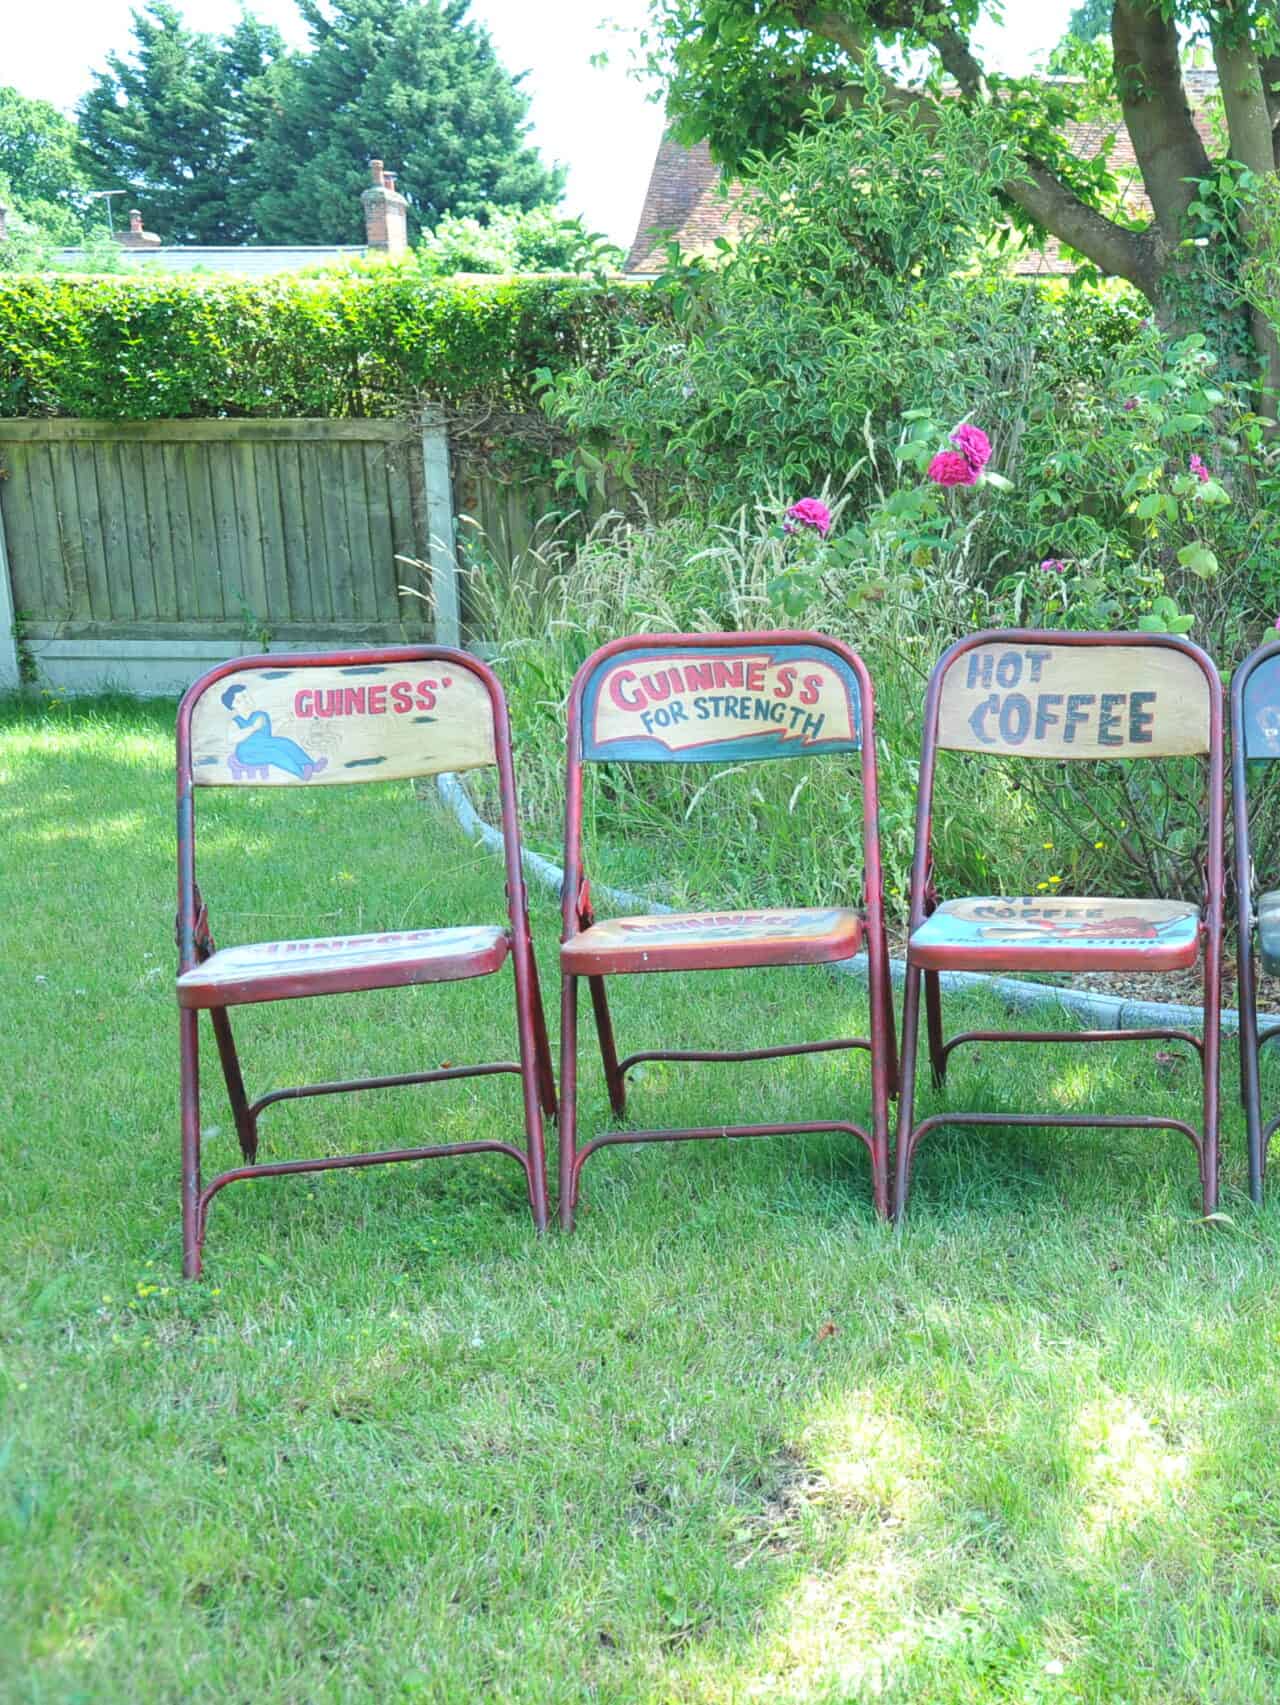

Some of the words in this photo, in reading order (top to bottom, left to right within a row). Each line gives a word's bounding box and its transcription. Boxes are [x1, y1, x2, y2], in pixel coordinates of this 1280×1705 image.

[609, 660, 823, 712] GUINNESS
[966, 651, 1052, 689] HOT
[640, 700, 689, 733] FOR
[693, 695, 825, 739] STRENGTH
[968, 692, 1157, 745] COFFEE
